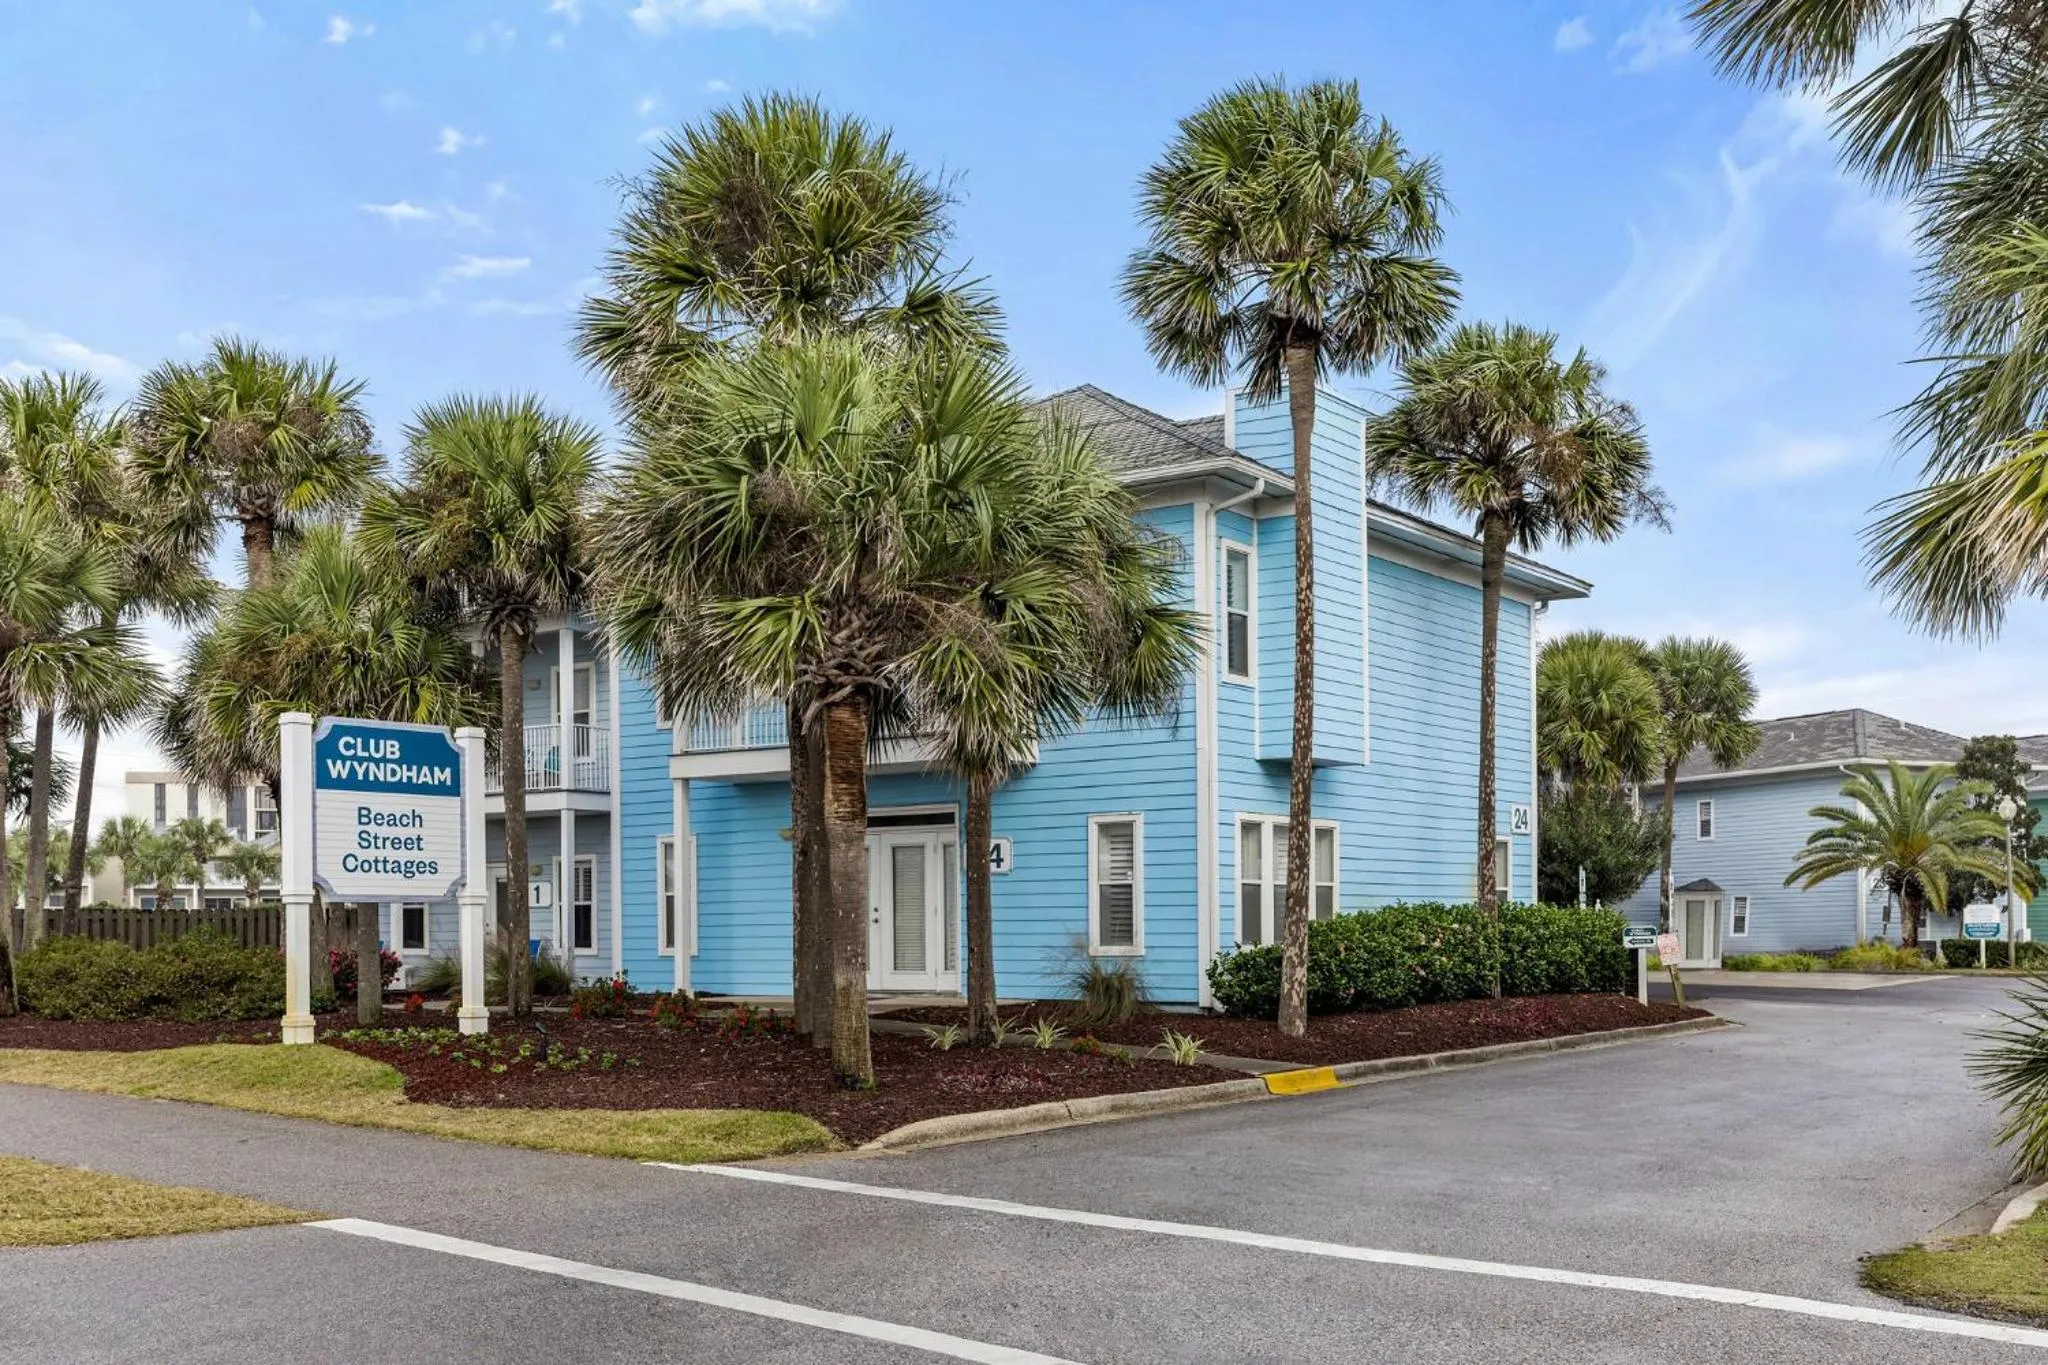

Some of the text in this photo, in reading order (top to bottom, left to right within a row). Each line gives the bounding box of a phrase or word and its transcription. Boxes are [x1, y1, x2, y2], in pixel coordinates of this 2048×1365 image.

[338, 736, 401, 760] CLUB
[327, 758, 452, 786] WYNDHAM
[357, 806, 423, 829] Beach
[1514, 807, 1528, 830] 24
[357, 830, 424, 851] Street
[342, 853, 439, 879] Cottages
